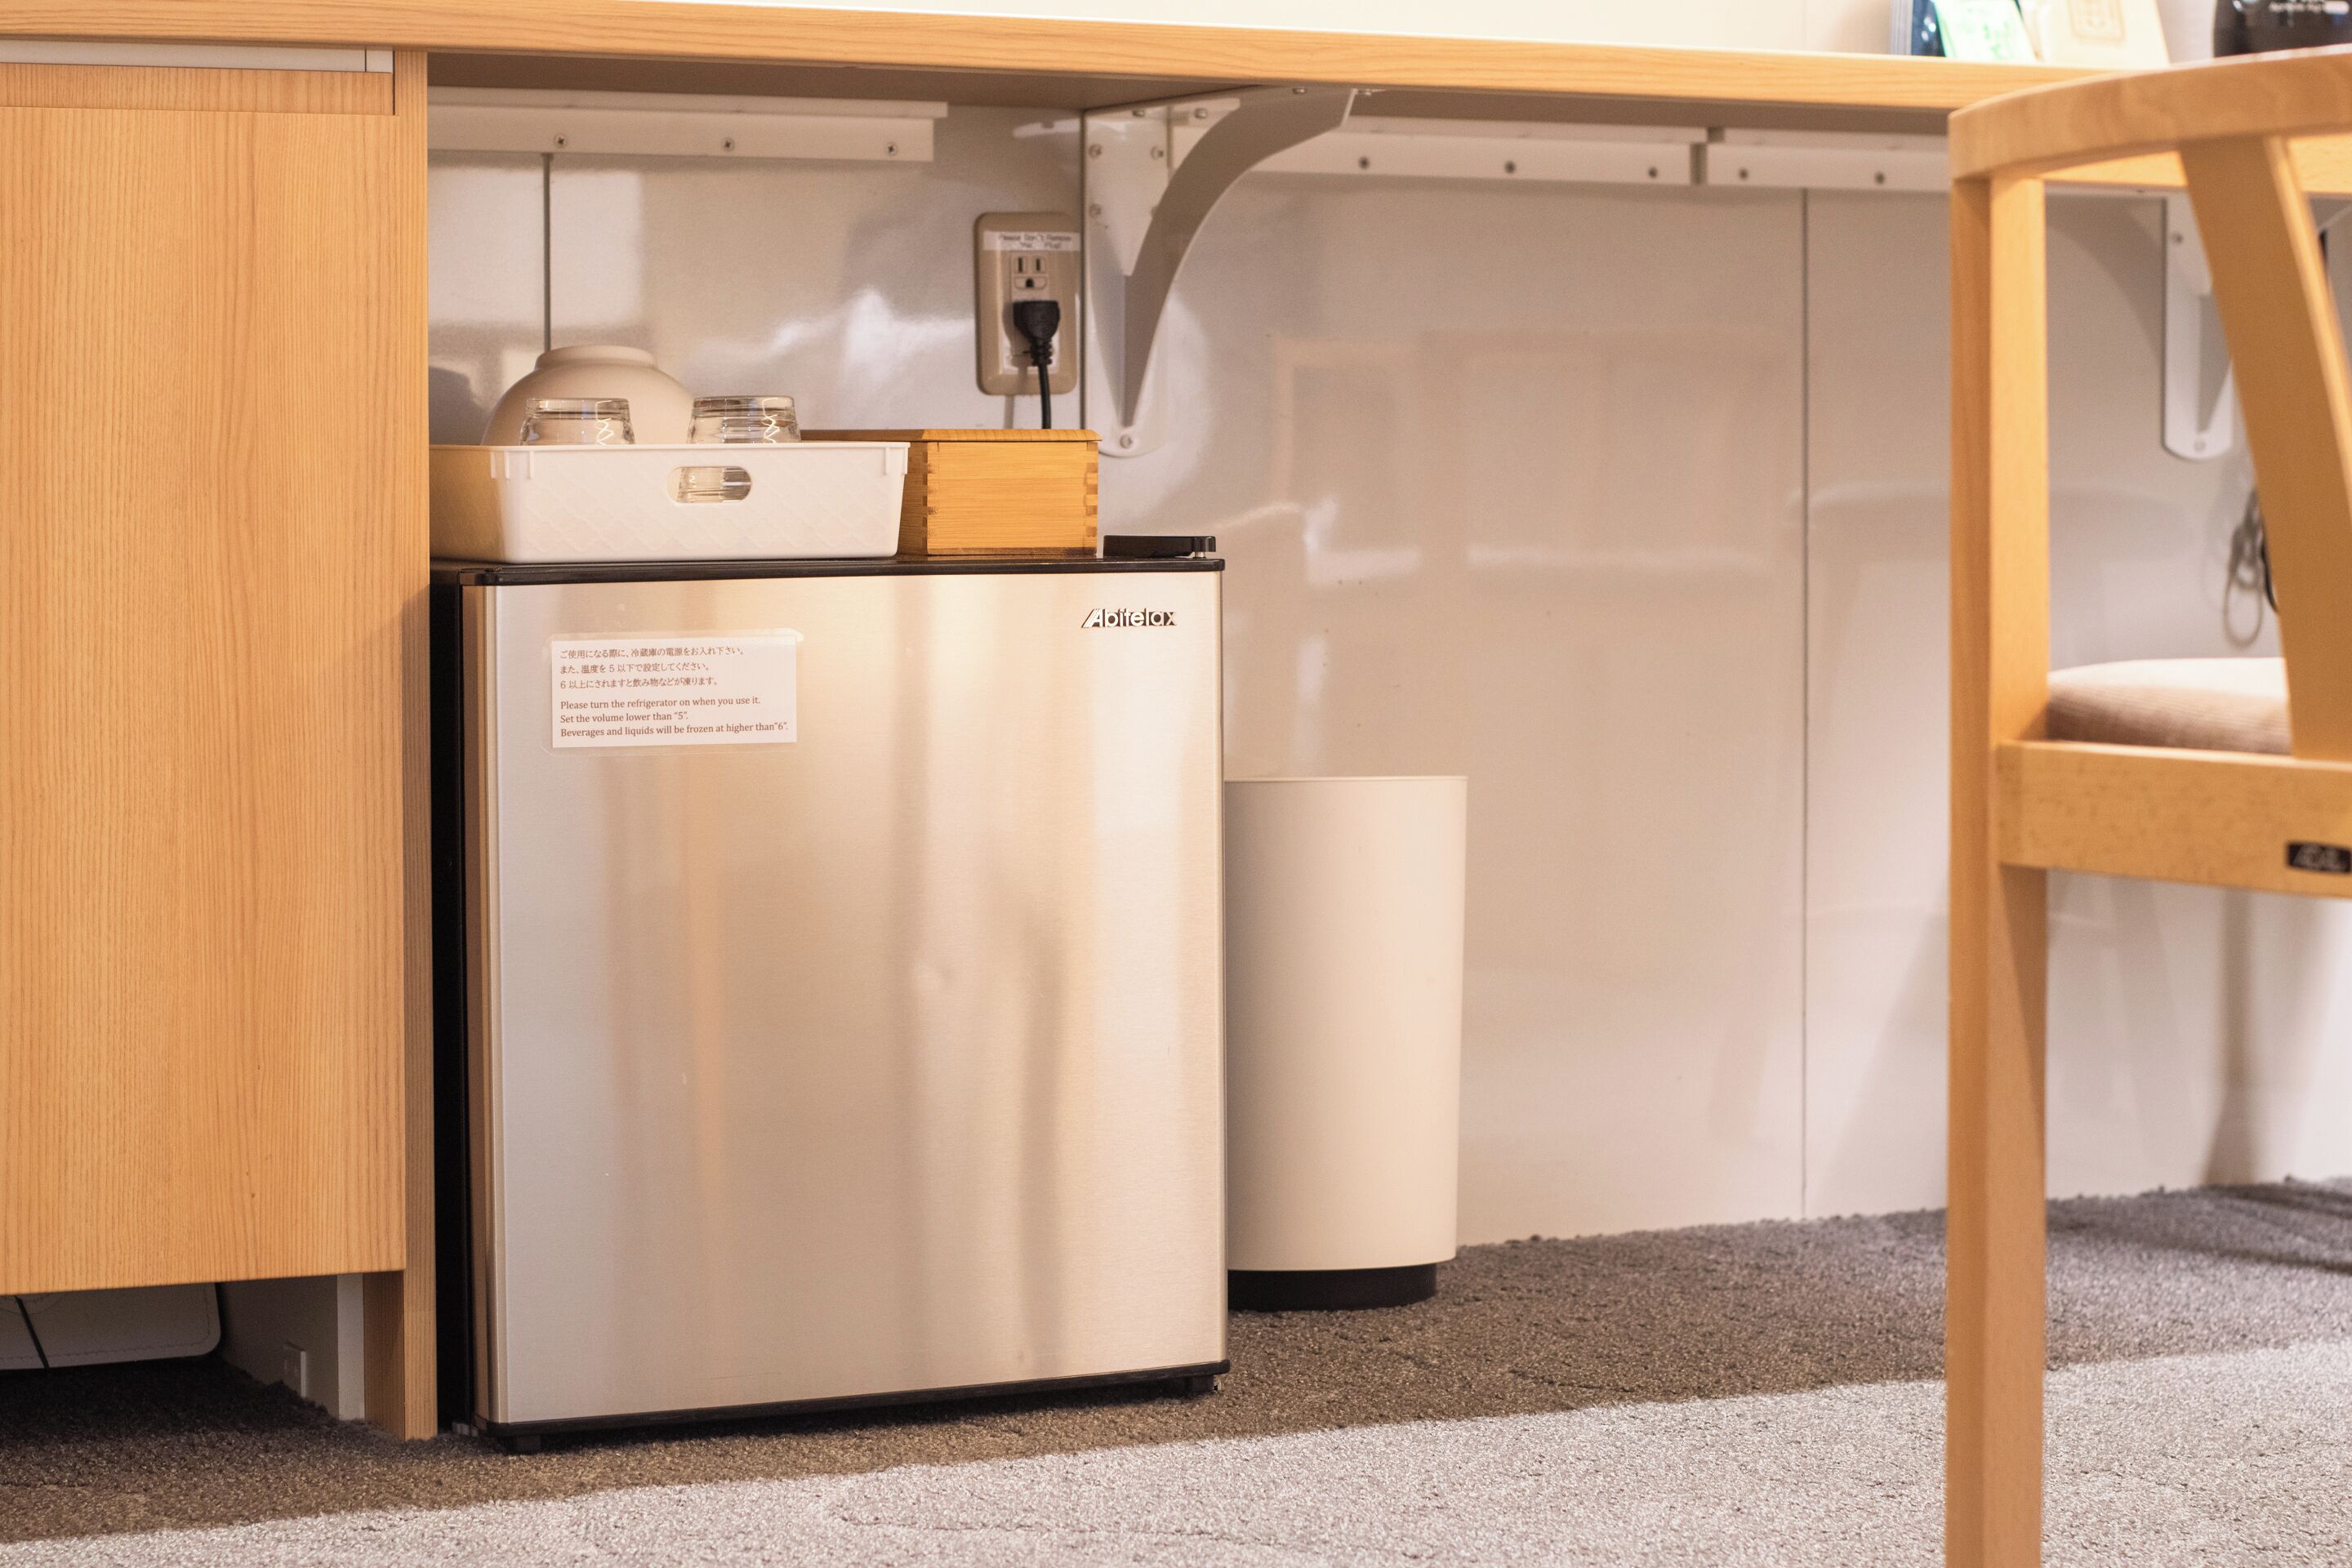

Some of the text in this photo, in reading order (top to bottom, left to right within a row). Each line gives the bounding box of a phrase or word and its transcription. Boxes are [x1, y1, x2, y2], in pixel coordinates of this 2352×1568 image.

[1081, 608, 1178, 628] Abitelax
[560, 701, 588, 710] Please
[590, 701, 609, 709] turn
[611, 699, 625, 710] the
[627, 699, 678, 710] refrigerator
[693, 697, 715, 706] when
[718, 699, 733, 707] you
[752, 696, 760, 704] it.
[560, 715, 574, 723] Set
[576, 714, 590, 722] the
[592, 713, 624, 724] volume
[626, 713, 651, 722] lower
[653, 712, 672, 721] than
[561, 726, 604, 738] Beverages
[607, 727, 622, 737] and
[625, 725, 654, 737] liquids
[656, 725, 672, 734] will
[675, 725, 684, 734] be
[687, 724, 714, 733] frozen
[726, 723, 754, 734] higher
